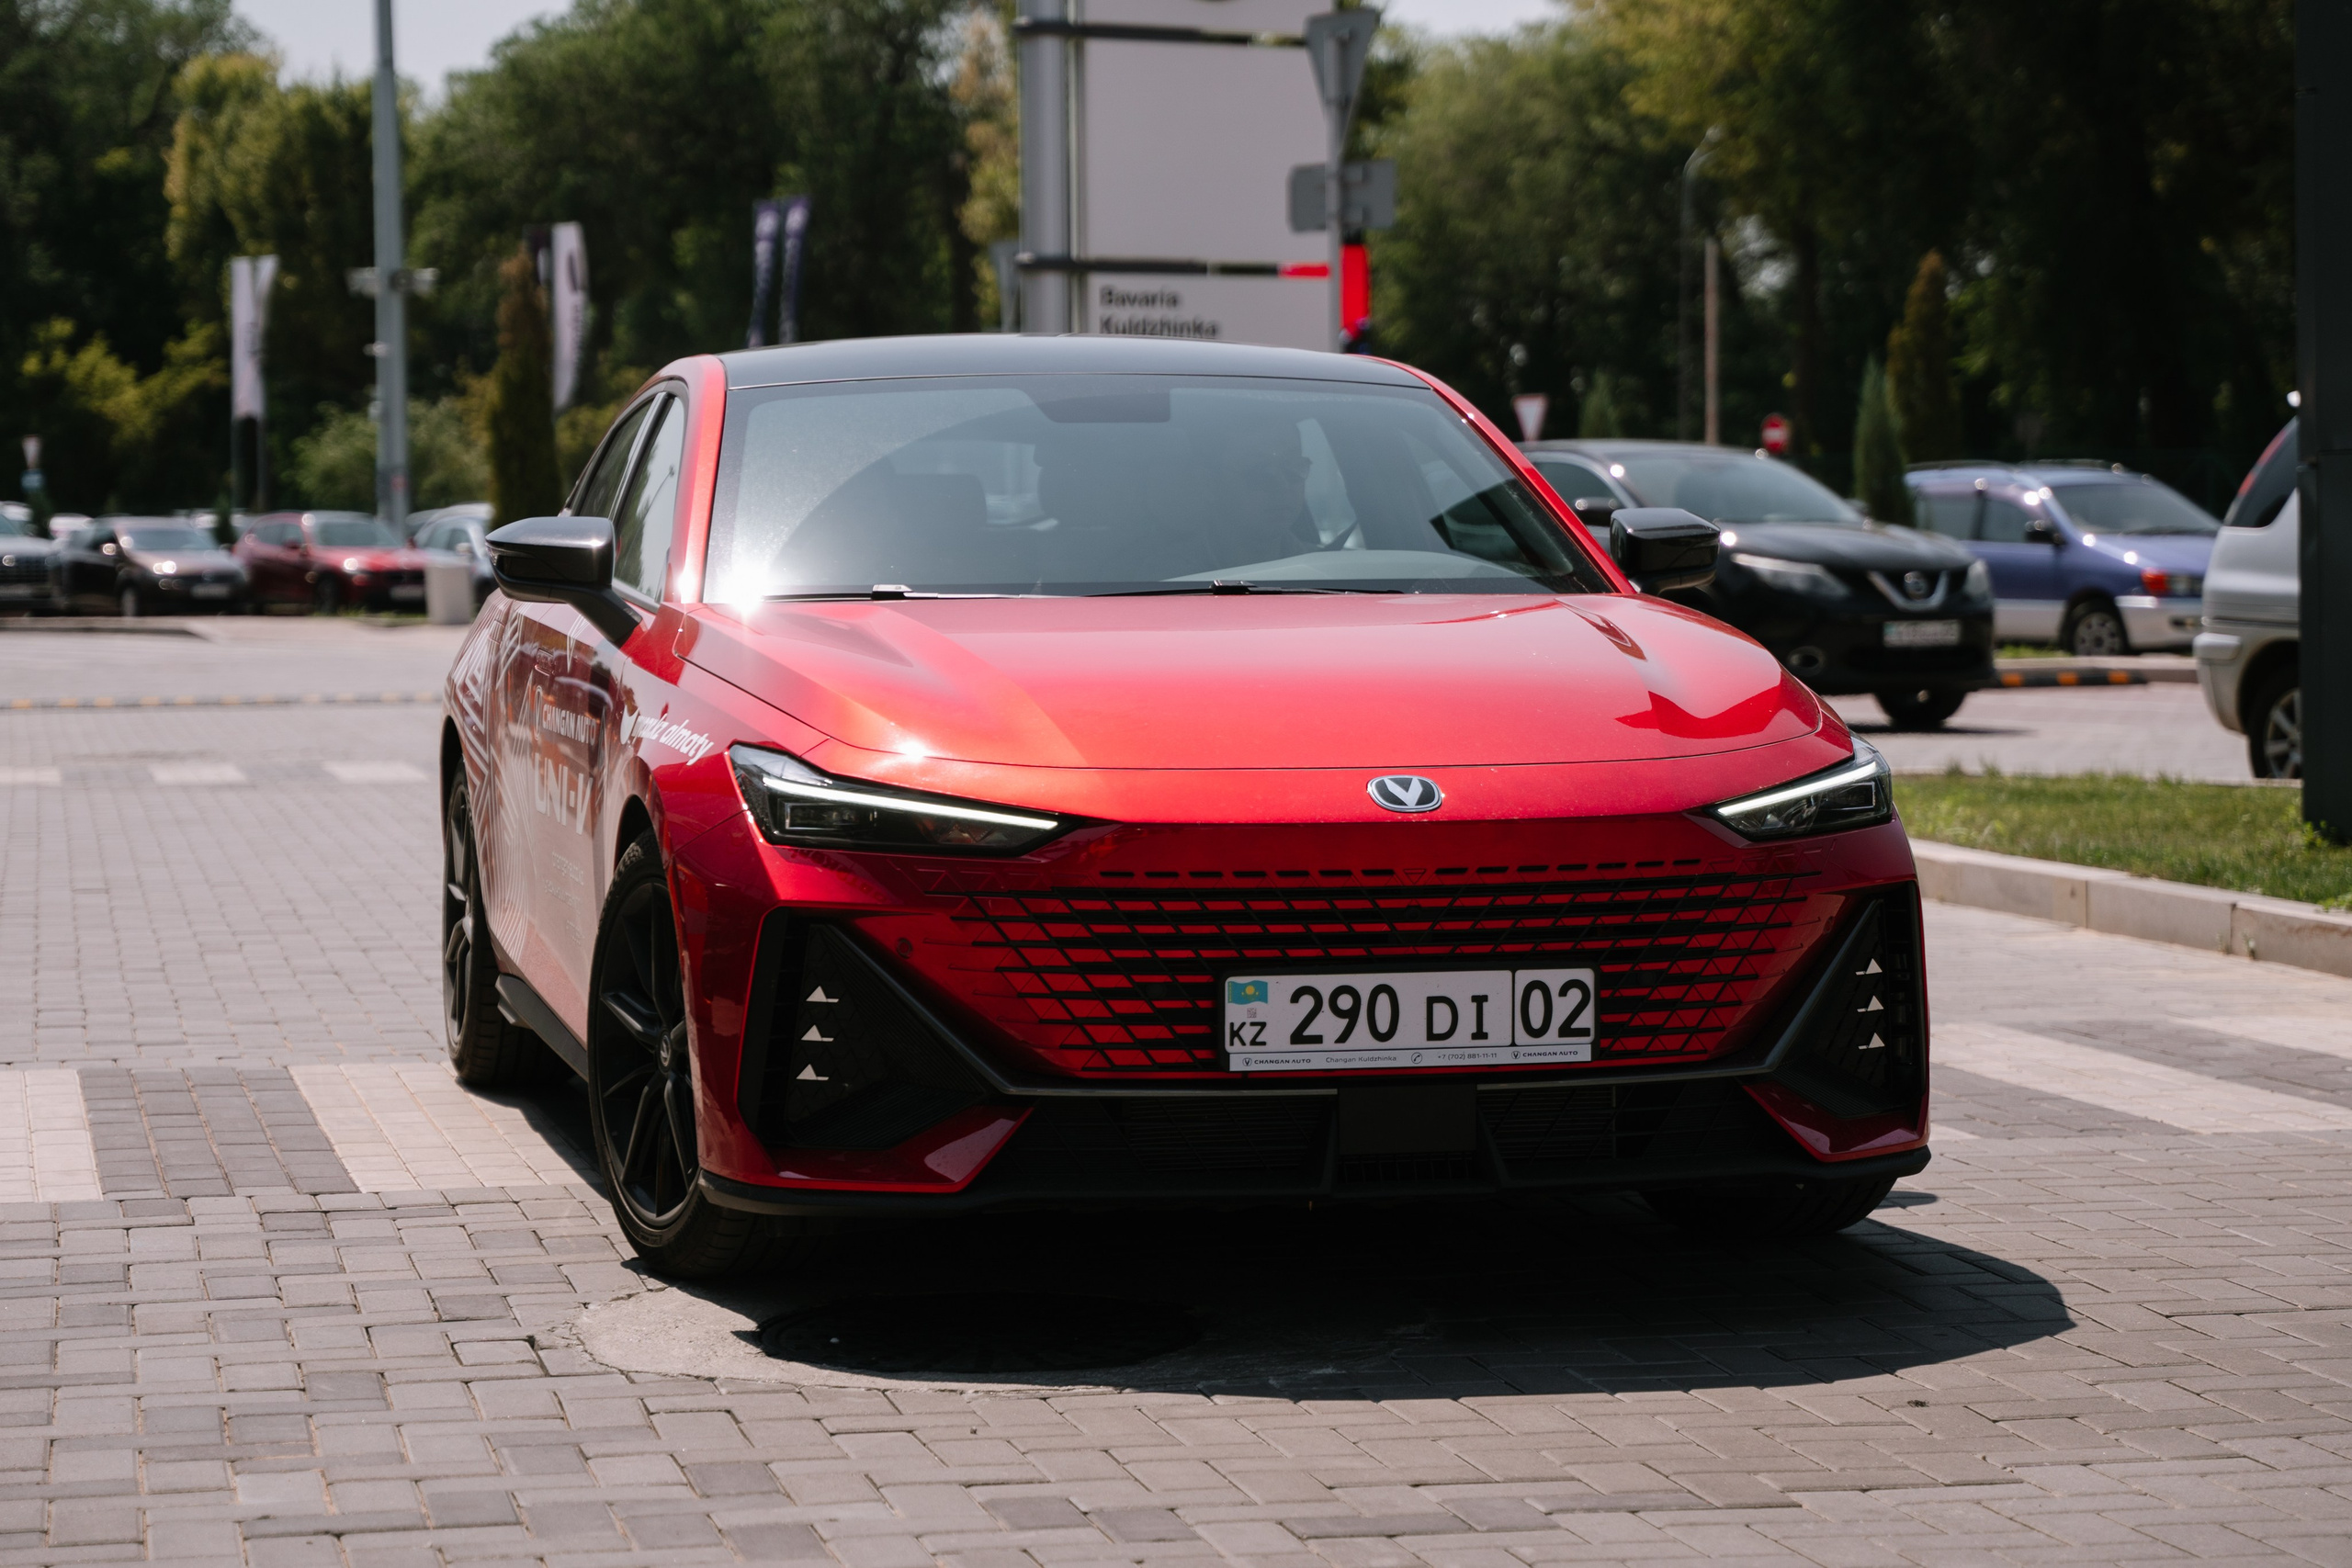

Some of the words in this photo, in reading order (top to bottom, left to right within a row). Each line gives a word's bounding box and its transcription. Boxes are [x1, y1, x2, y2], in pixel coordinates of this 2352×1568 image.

[1100, 287, 1180, 307] Bavaria
[1100, 315, 1218, 339] Kuldzhinka
[542, 703, 576, 739] CHANGAN
[575, 714, 597, 746] AUTO
[659, 718, 715, 766] almaty
[535, 752, 594, 836] UNI-V
[1290, 983, 1399, 1045] 290
[1426, 995, 1488, 1042] DI
[1520, 978, 1591, 1039] 02
[1228, 1021, 1267, 1046] KZ
[1447, 1053, 1465, 1061] (702)
